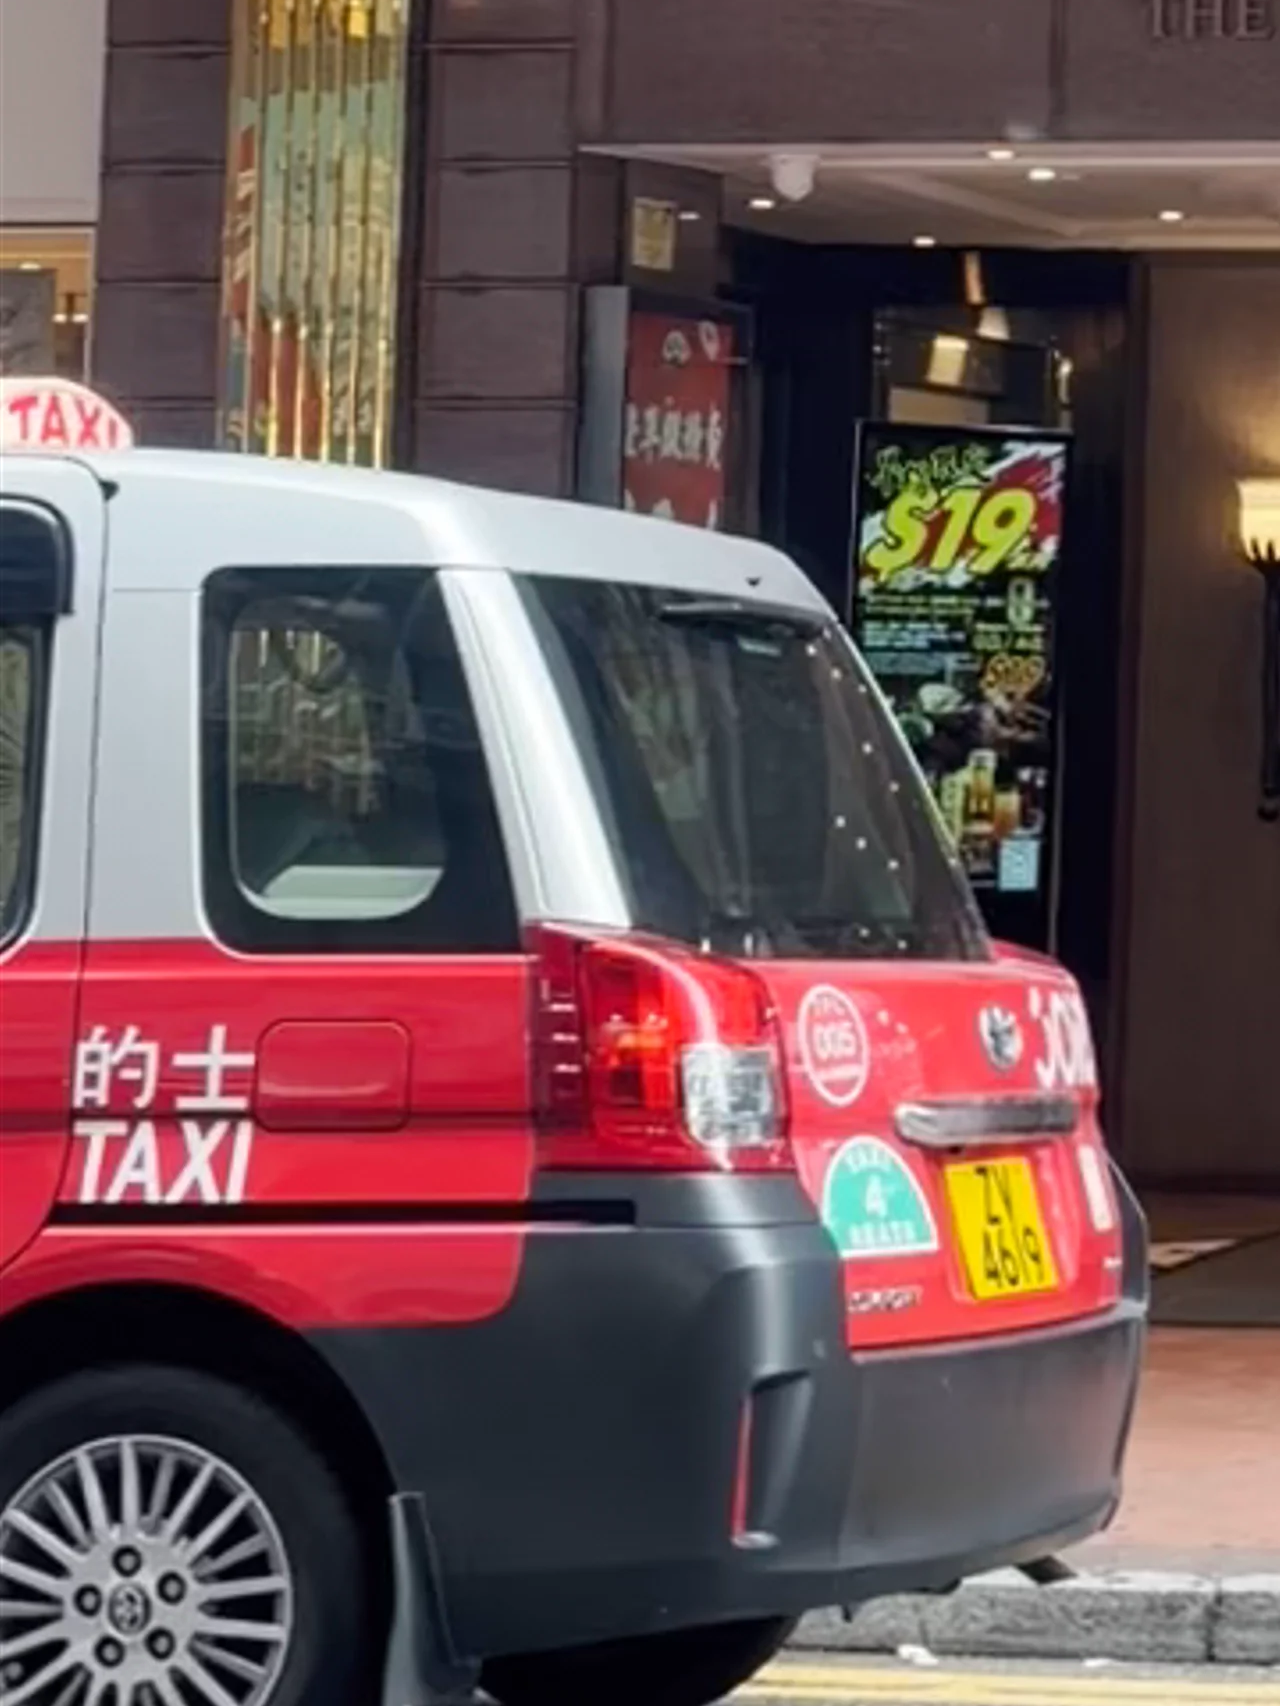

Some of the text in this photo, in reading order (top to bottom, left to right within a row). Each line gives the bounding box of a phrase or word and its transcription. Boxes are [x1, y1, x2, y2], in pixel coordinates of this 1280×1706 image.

[8, 390, 118, 450] TAXI
[867, 474, 1038, 584] $19
[74, 1023, 256, 1110] 的士
[74, 1120, 256, 1204] TAXI
